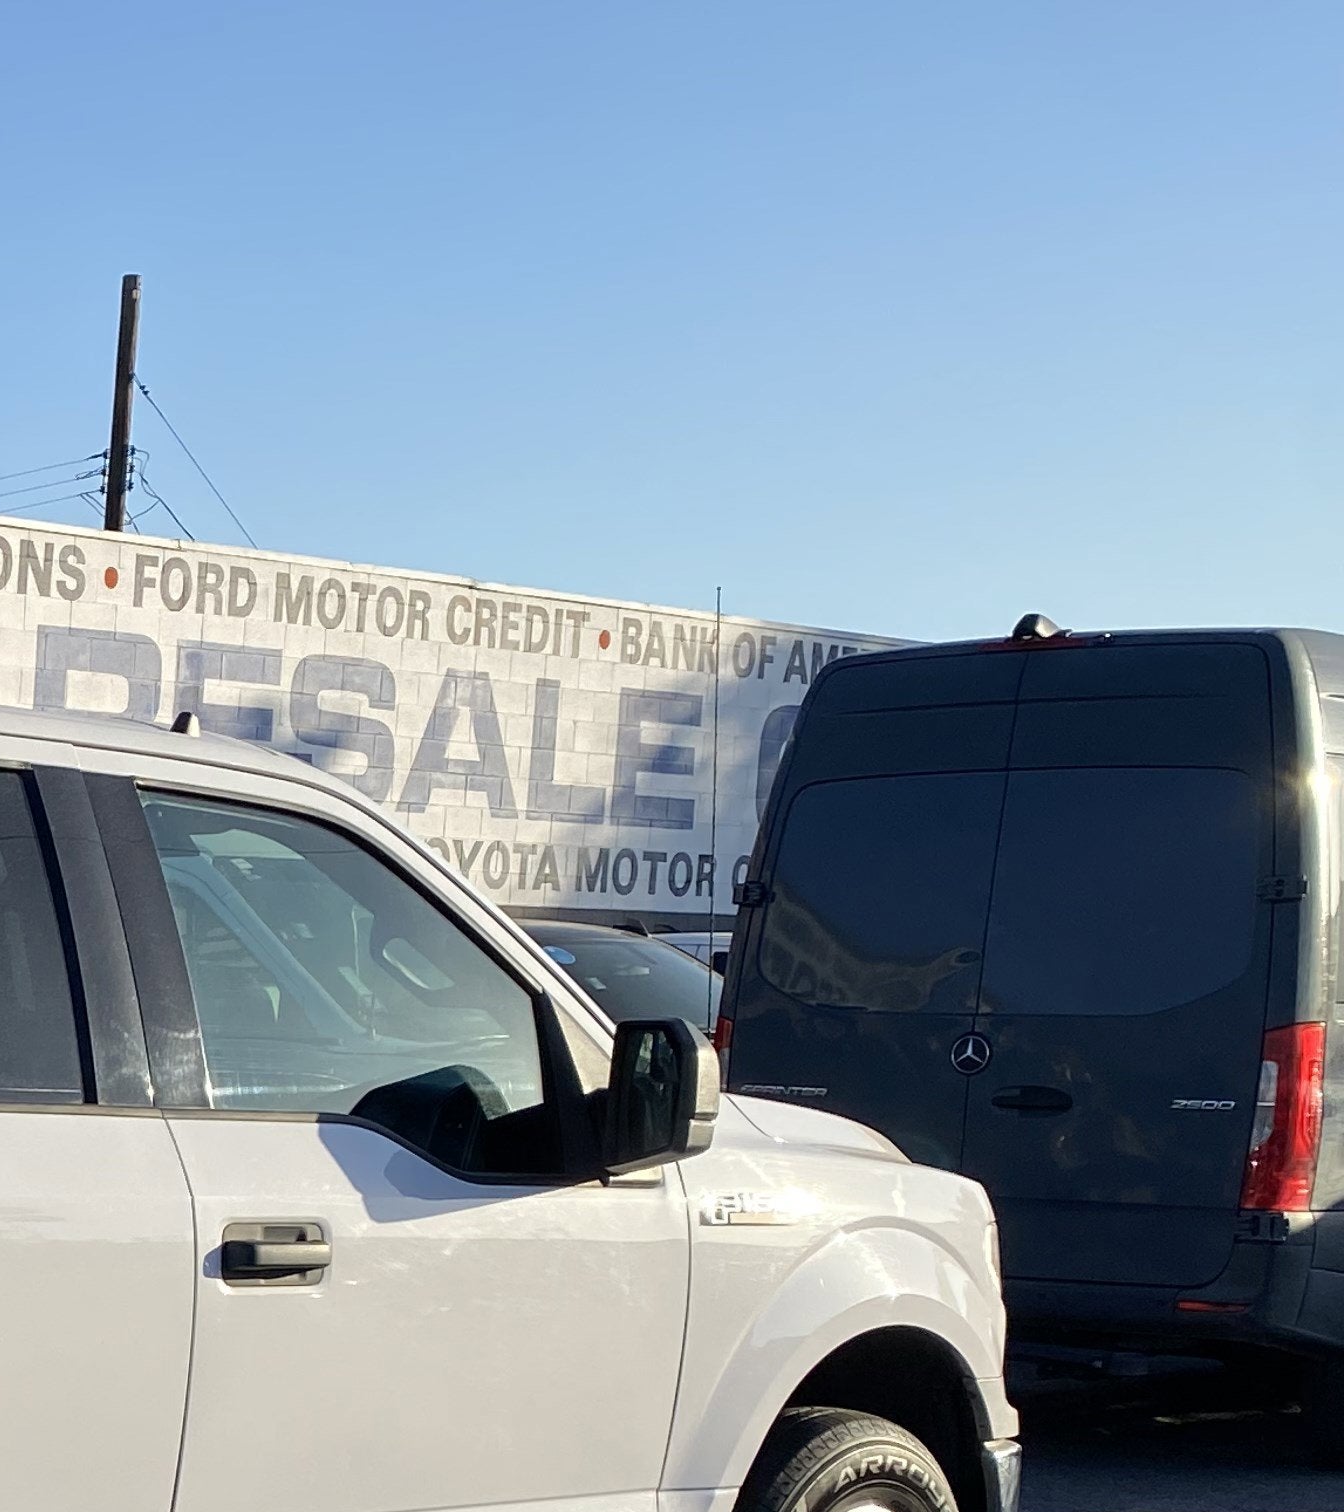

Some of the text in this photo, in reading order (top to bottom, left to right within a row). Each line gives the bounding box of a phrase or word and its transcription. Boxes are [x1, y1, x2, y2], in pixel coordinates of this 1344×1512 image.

[132, 553, 257, 618] FORD
[273, 573, 431, 641] MOTOR
[446, 594, 592, 658] CREDIT
[621, 617, 718, 673] BANK
[732, 632, 777, 680] OF
[575, 847, 716, 897] MOTOR
[1170, 1099, 1236, 1109] 2500
